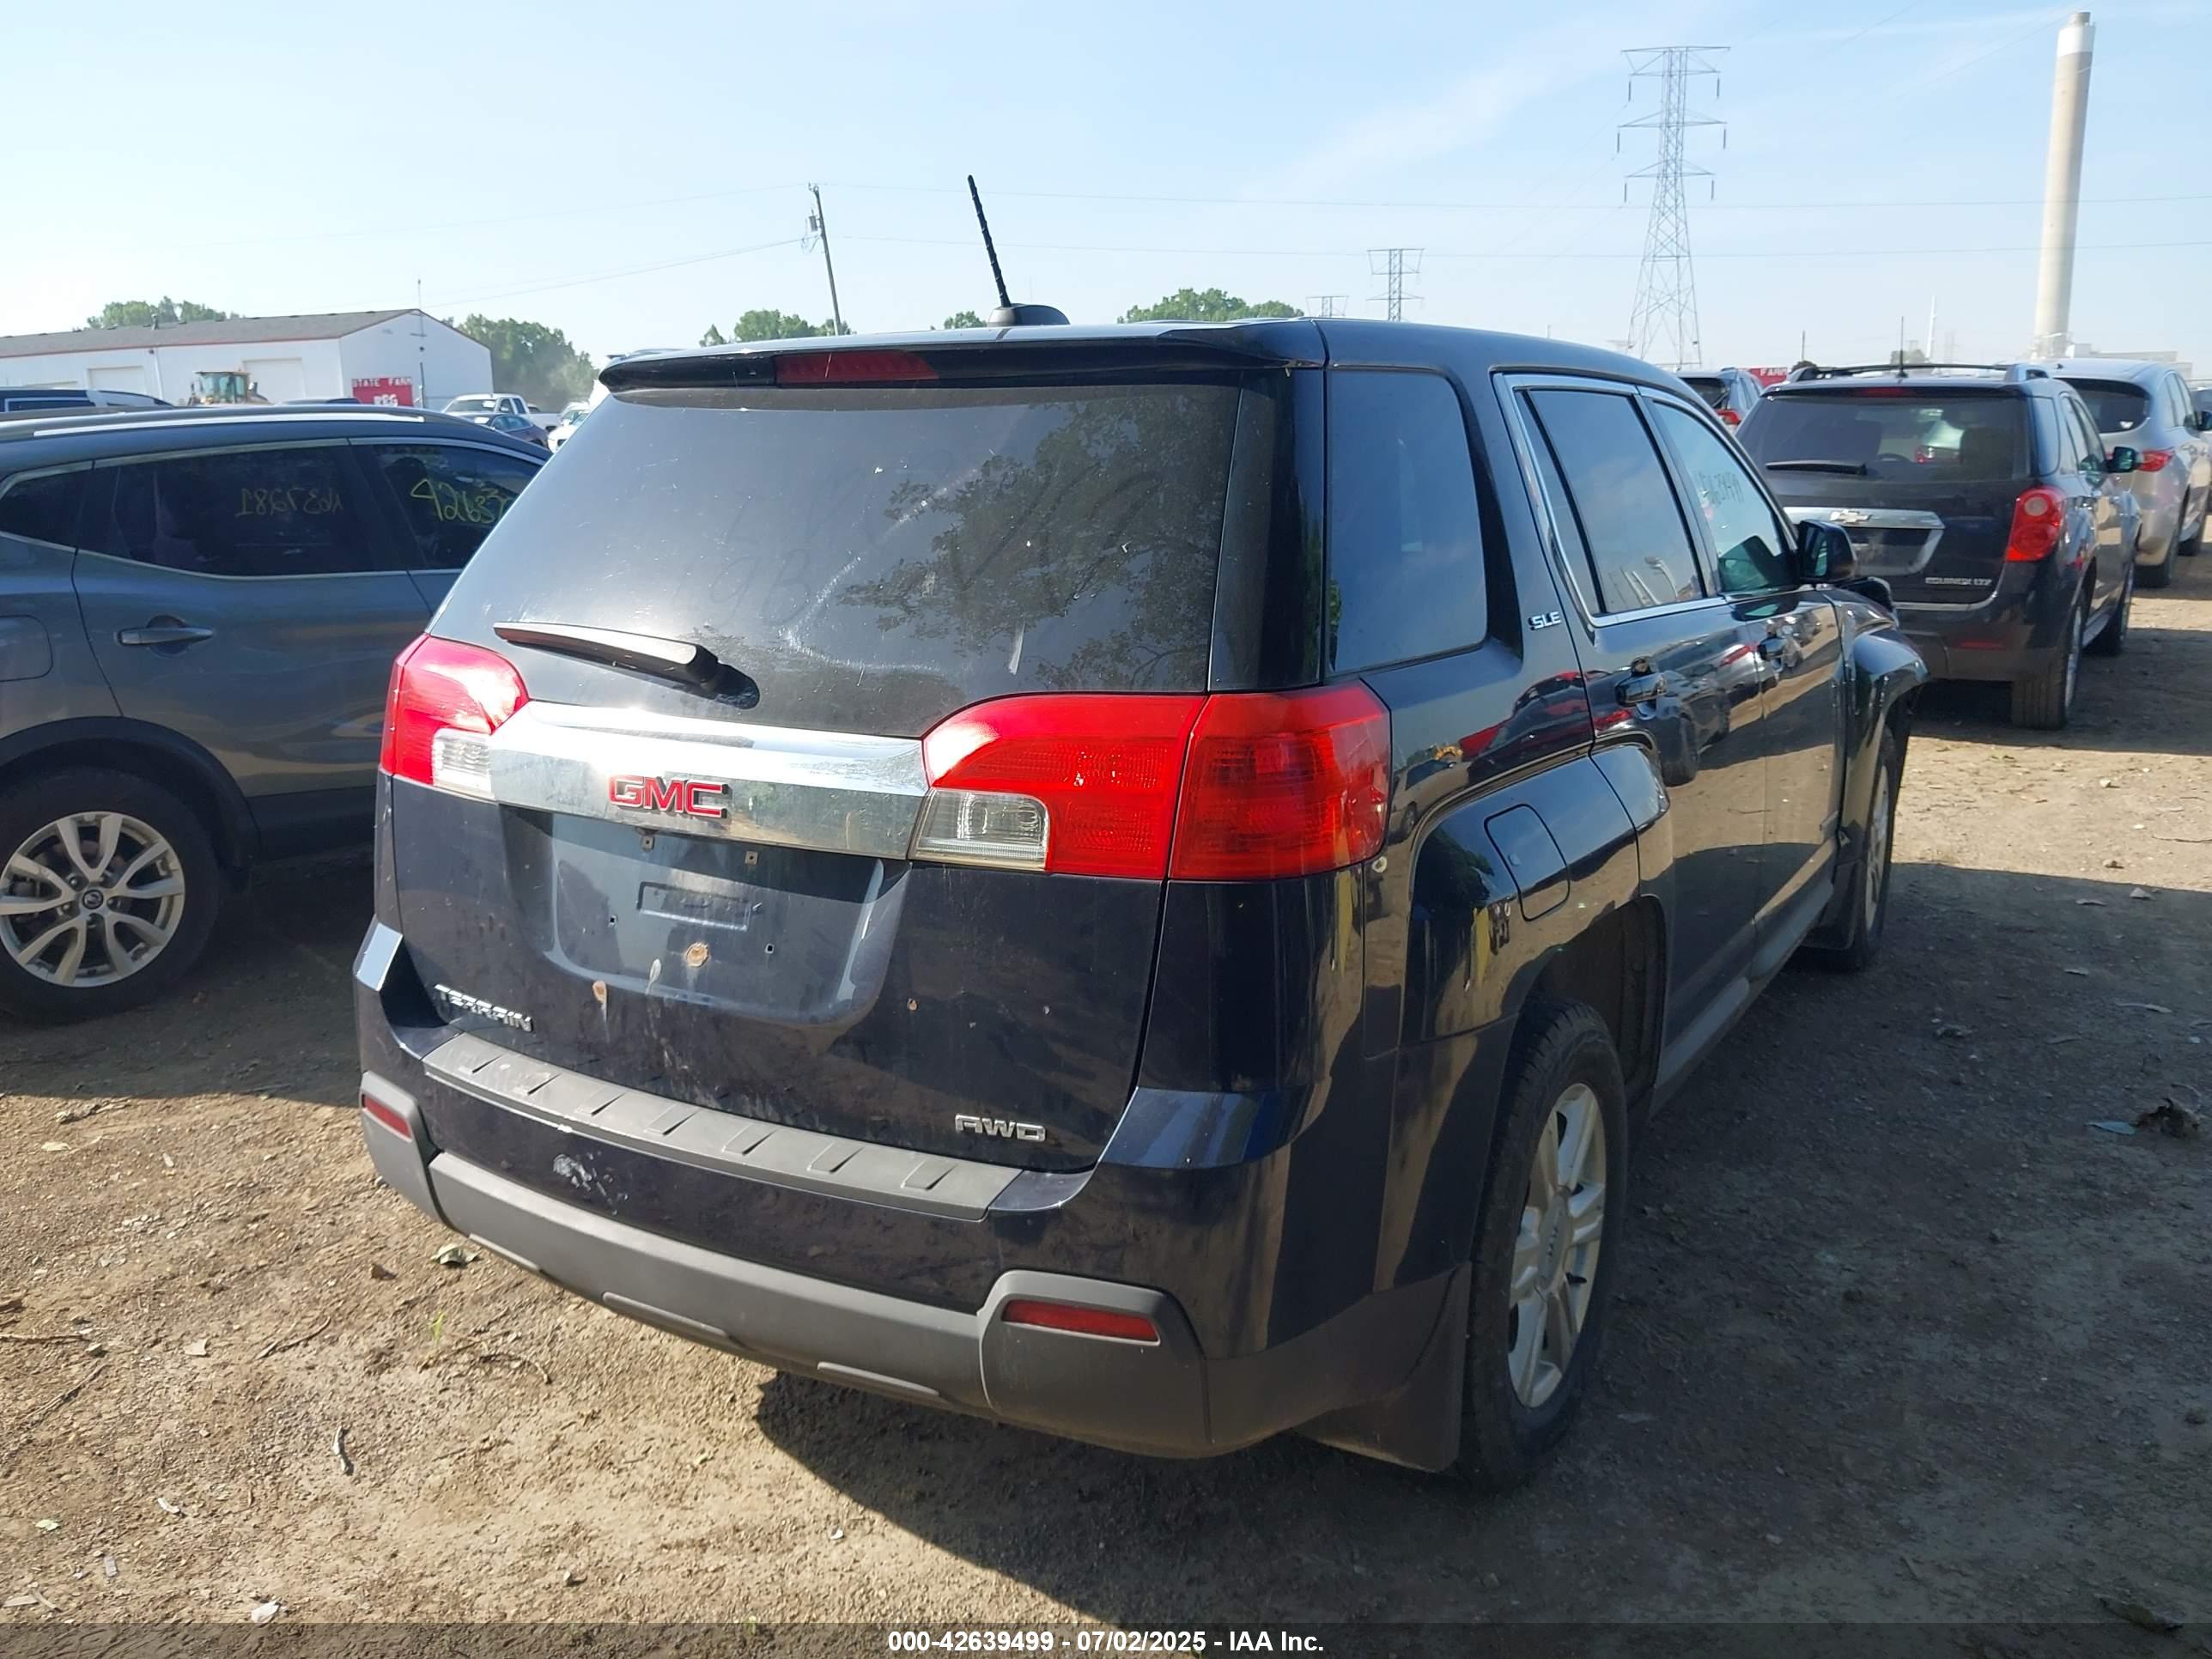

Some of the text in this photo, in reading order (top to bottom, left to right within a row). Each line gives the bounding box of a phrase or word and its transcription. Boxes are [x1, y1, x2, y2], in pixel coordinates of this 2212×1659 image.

[352, 379, 380, 387] STATE
[1530, 611, 1561, 630] SLE
[609, 775, 729, 818] GMC
[955, 1115, 1046, 1142] AWD
